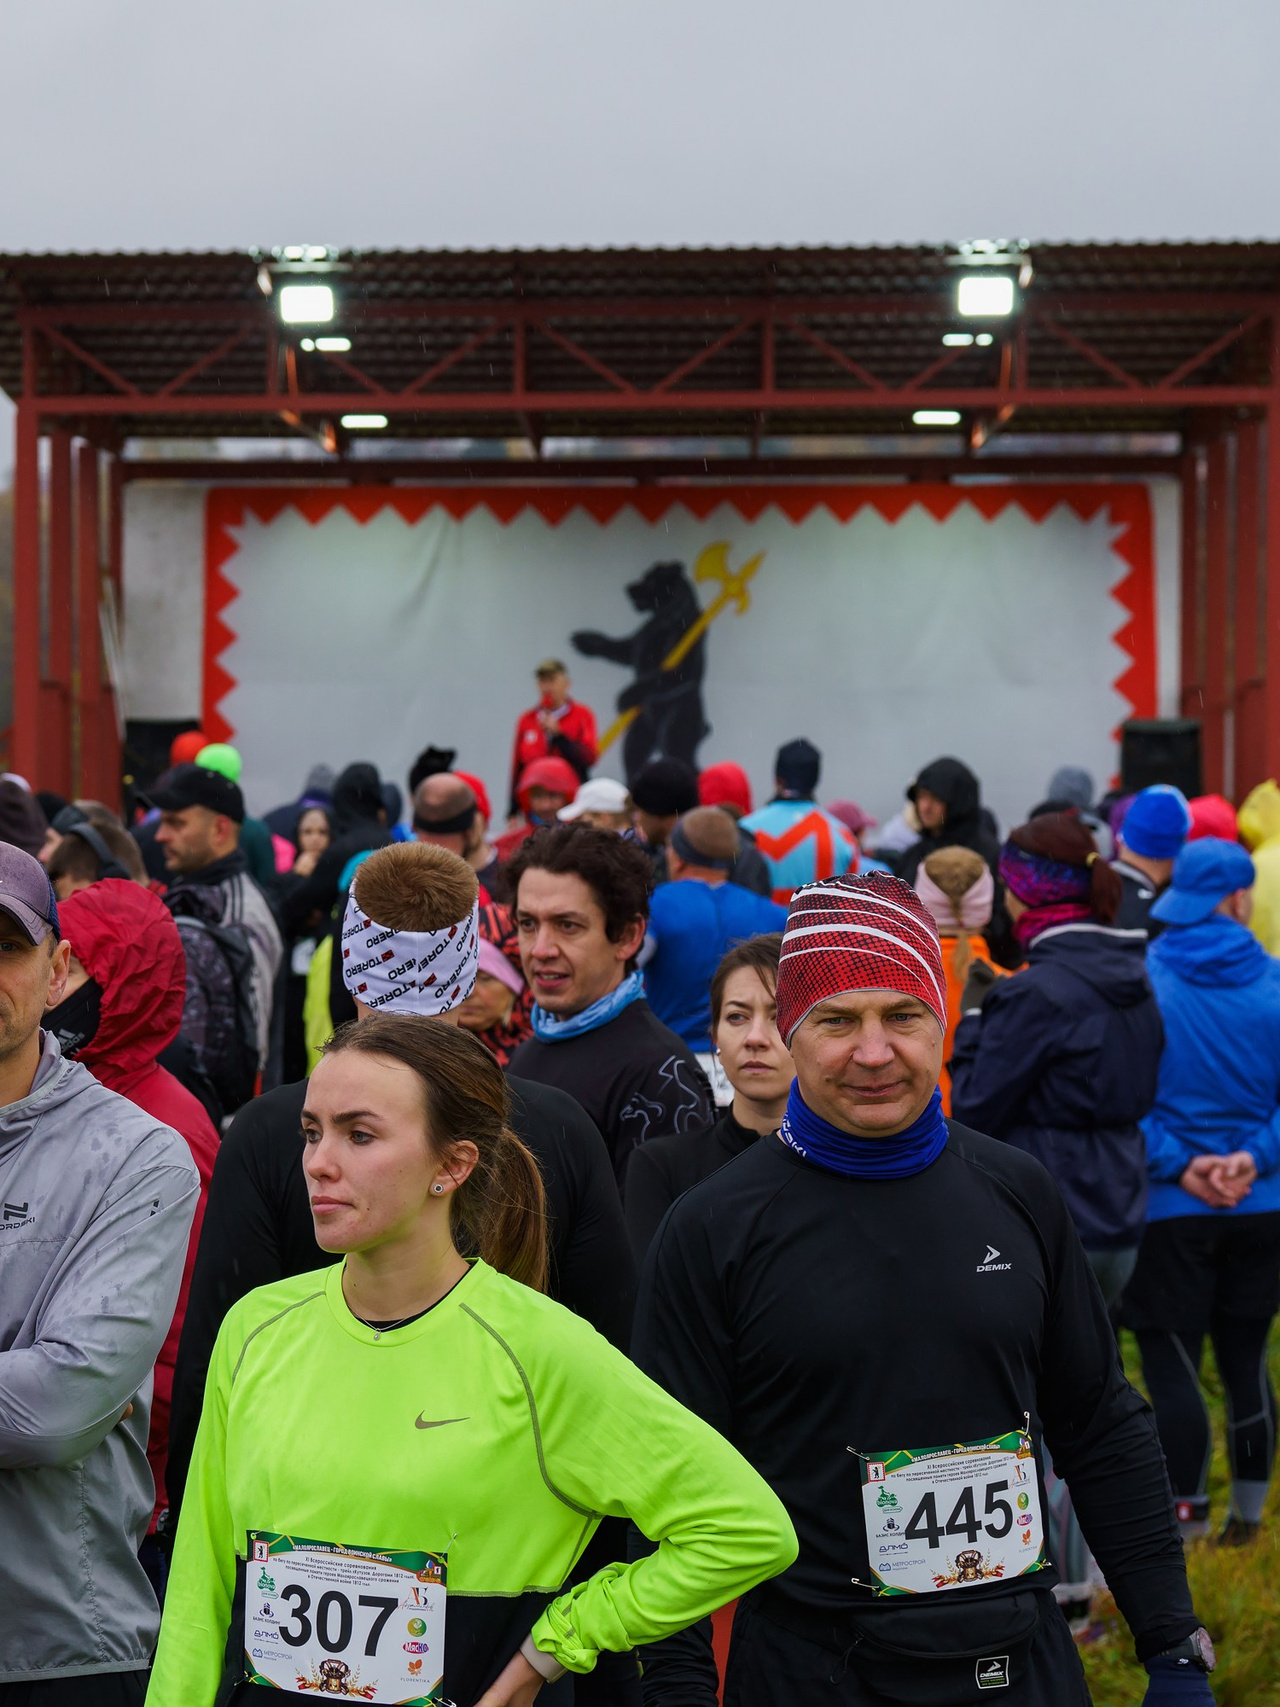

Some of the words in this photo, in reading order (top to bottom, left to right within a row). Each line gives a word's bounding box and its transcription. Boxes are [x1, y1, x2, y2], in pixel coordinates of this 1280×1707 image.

[345, 956, 382, 978] TORERO
[434, 950, 471, 998] TORERO
[976, 1263, 1012, 1272] DEMIX
[904, 1480, 1013, 1549] 445
[278, 1584, 399, 1657] 307
